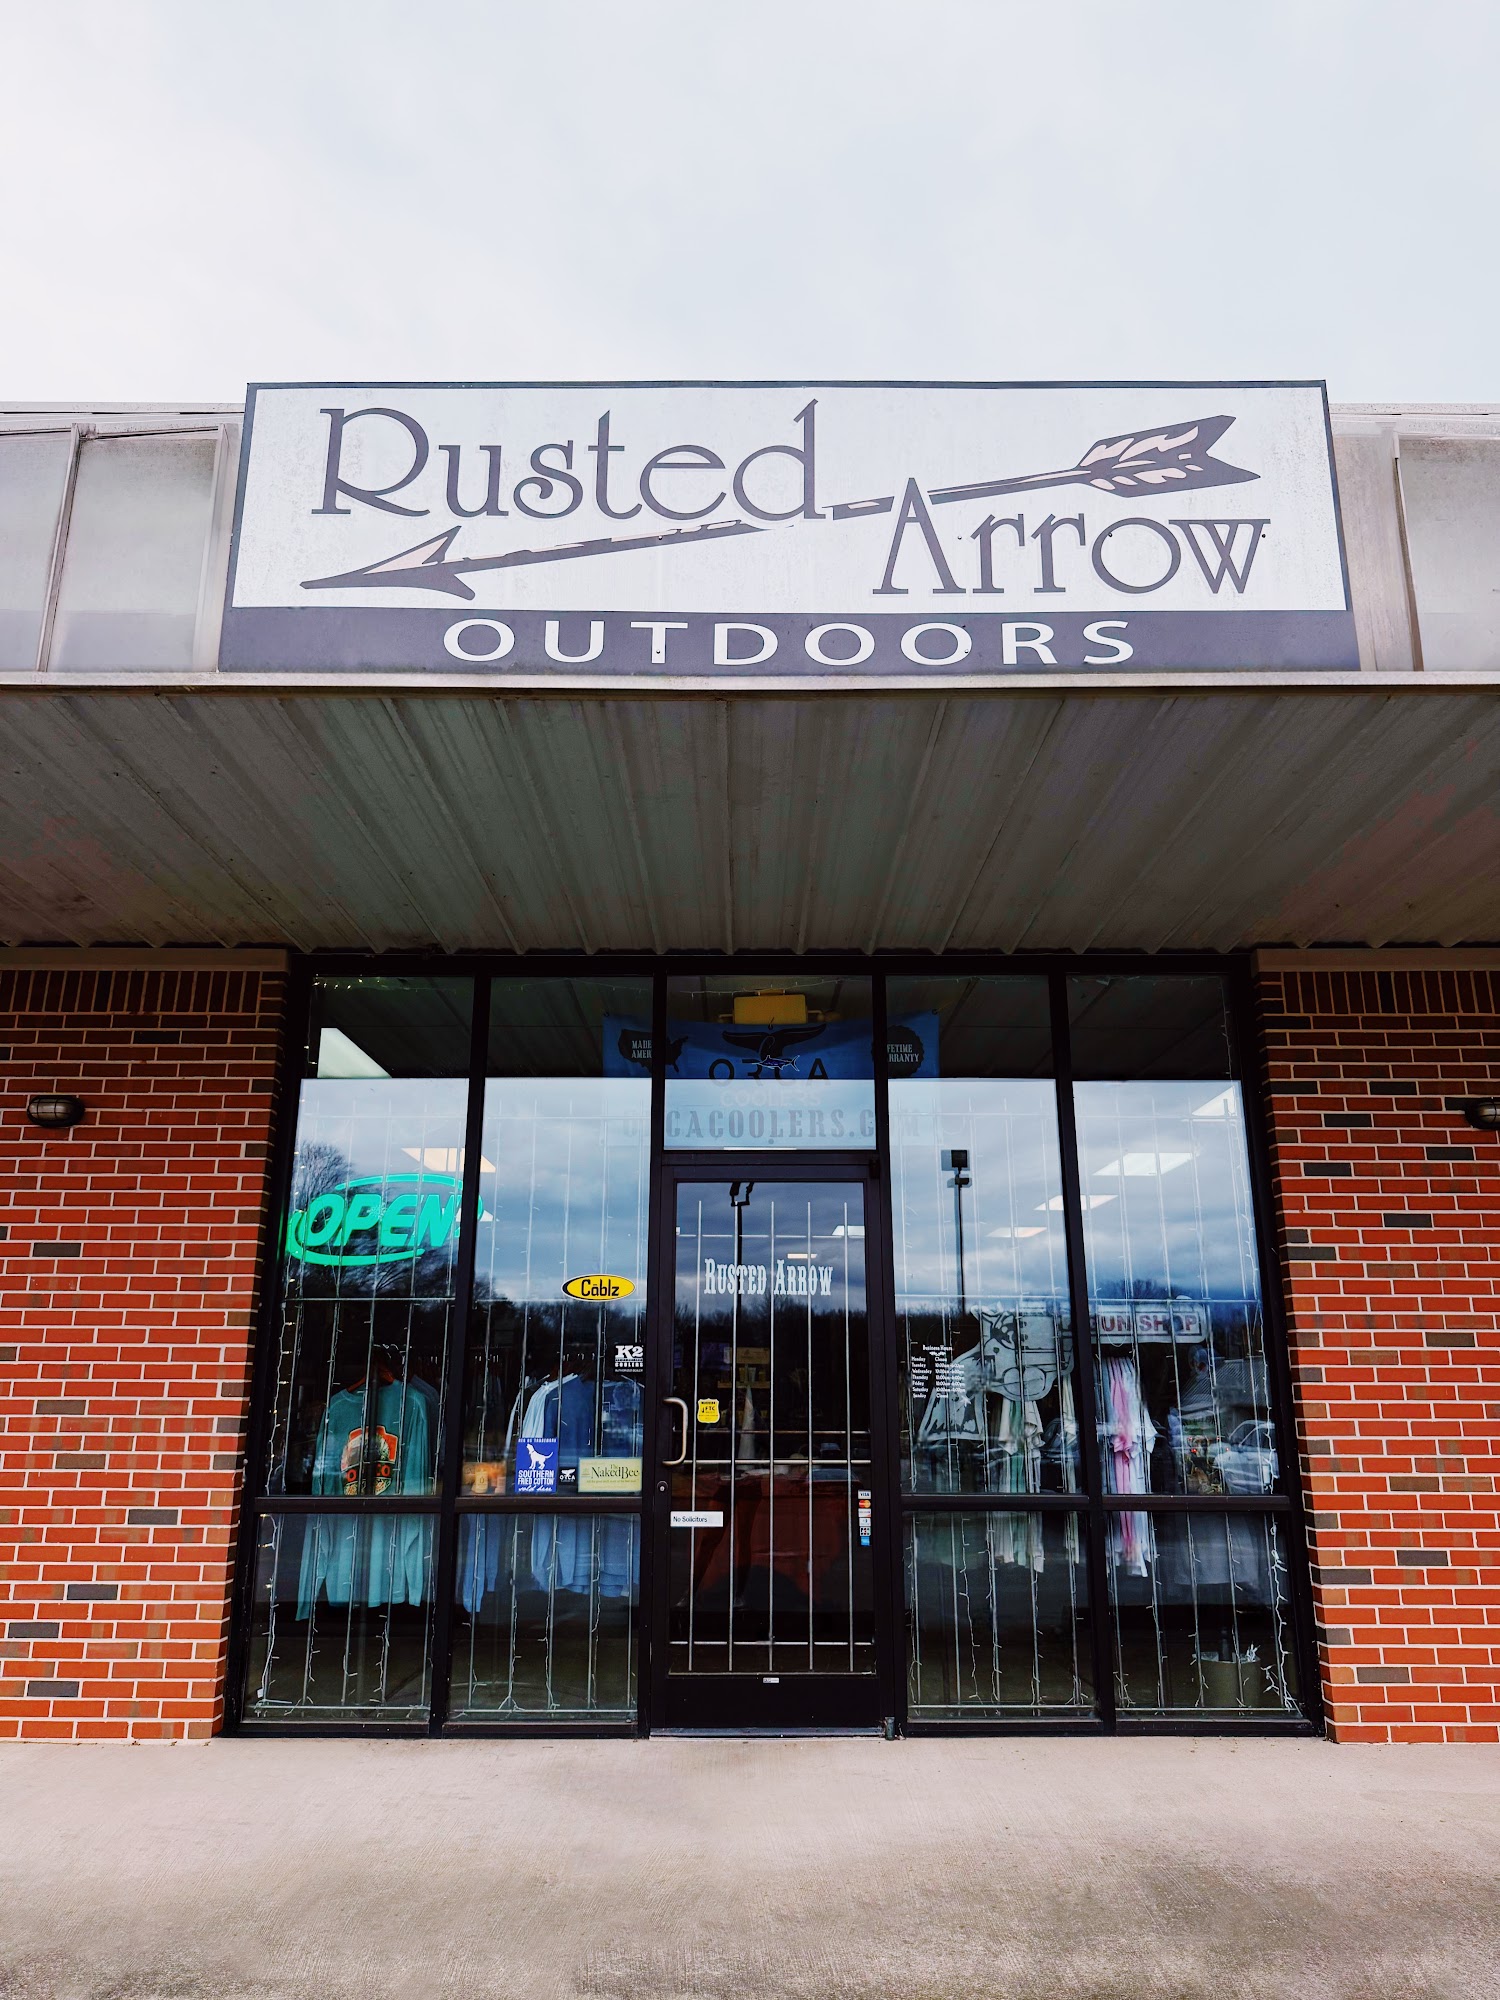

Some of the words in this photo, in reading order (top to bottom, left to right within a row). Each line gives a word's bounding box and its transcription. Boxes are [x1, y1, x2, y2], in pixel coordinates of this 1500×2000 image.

[311, 398, 827, 521] Rusted
[872, 477, 1271, 595] Arrow
[443, 618, 1134, 666] OUTDOORS
[631, 1040, 652, 1049] MADE
[887, 1044, 913, 1053] FETIME
[631, 1050, 652, 1059] AMER
[888, 1053, 919, 1063] RRANTY
[304, 1193, 463, 1247] OPEN
[1139, 1314, 1197, 1332] SHOP
[615, 1344, 644, 1358] K2
[518, 1469, 555, 1478] SOUTHERN
[517, 1477, 533, 1485] FRIED
[533, 1477, 555, 1485] COTTON
